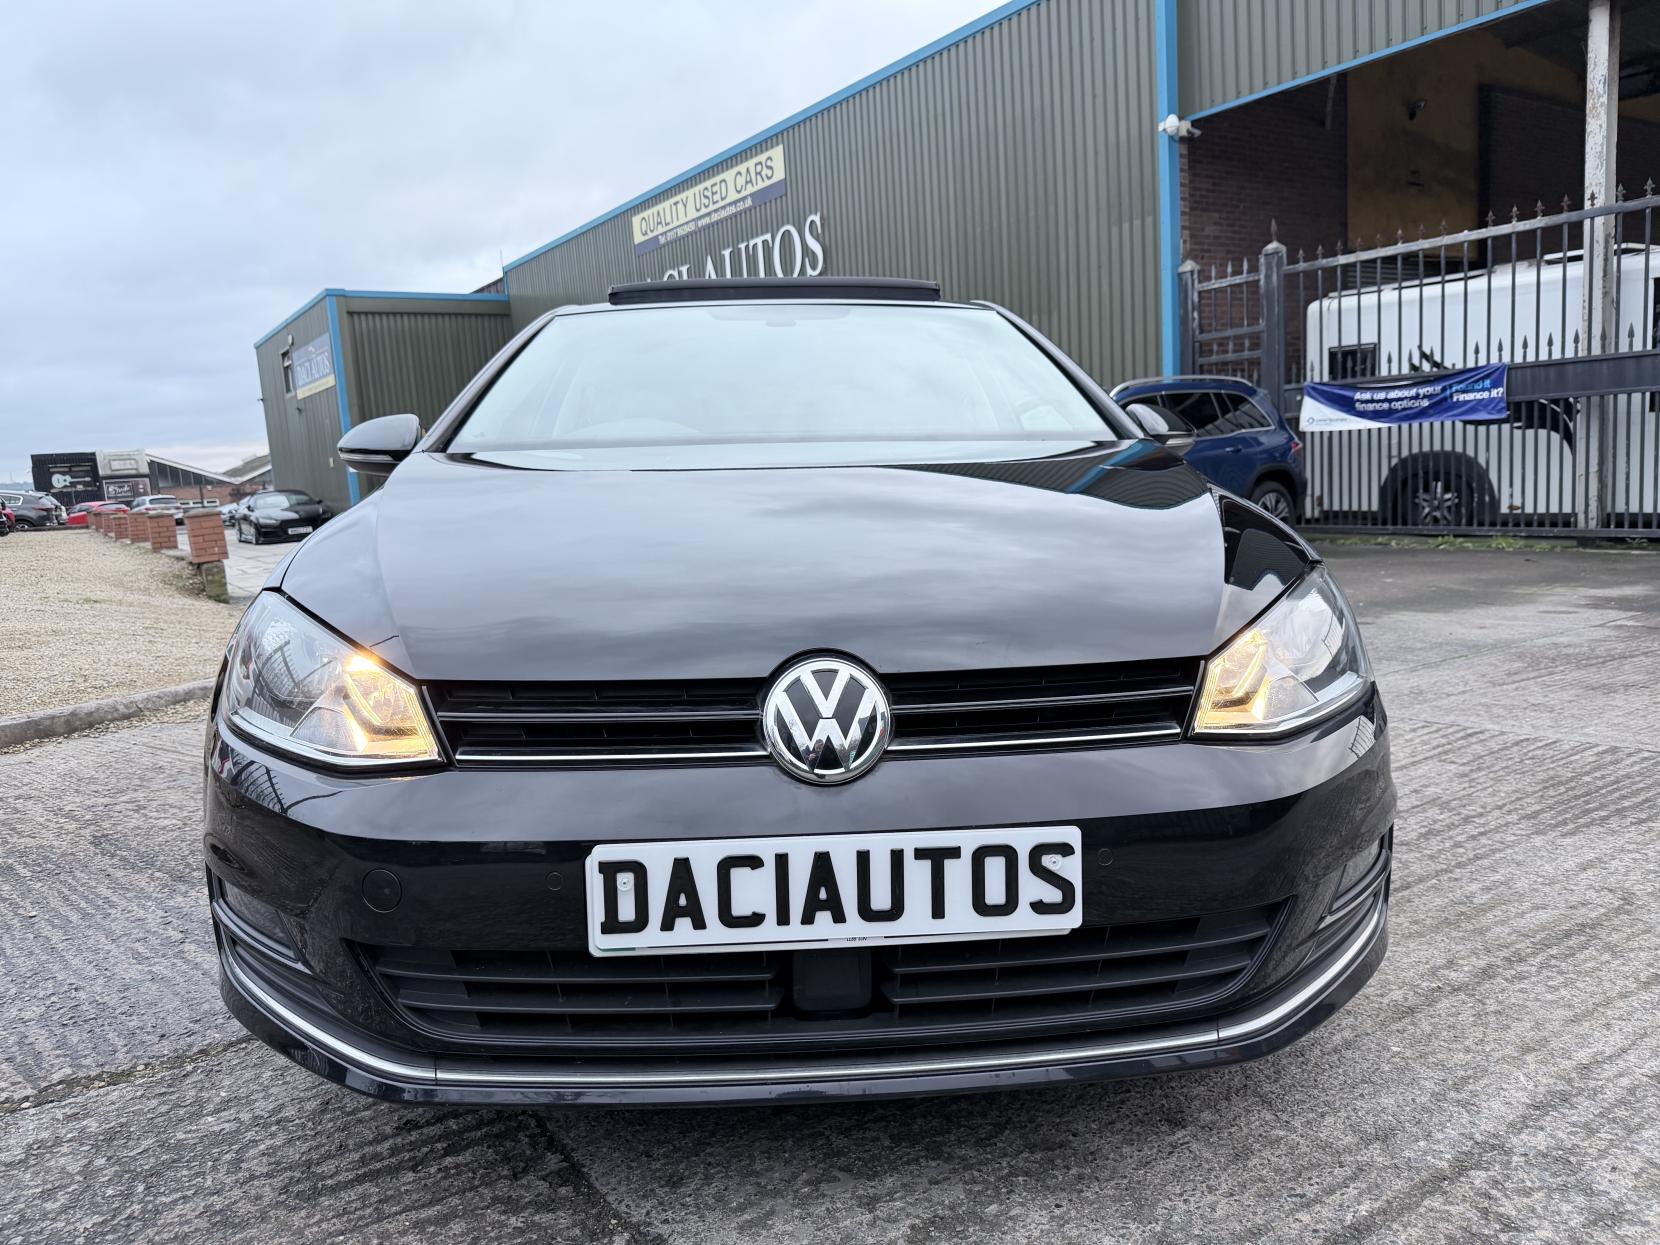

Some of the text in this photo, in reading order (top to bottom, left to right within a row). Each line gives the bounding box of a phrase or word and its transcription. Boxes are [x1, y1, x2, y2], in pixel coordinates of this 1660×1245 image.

[640, 194, 690, 237] QUALITY
[694, 178, 728, 212] USED
[734, 156, 775, 194] CARS
[1353, 385, 1443, 401] Ask us about your
[1451, 379, 1491, 392] Found it
[1452, 387, 1504, 402] Finance it?
[1354, 397, 1430, 412] finance options
[598, 842, 1076, 935] DACIAUTOS
